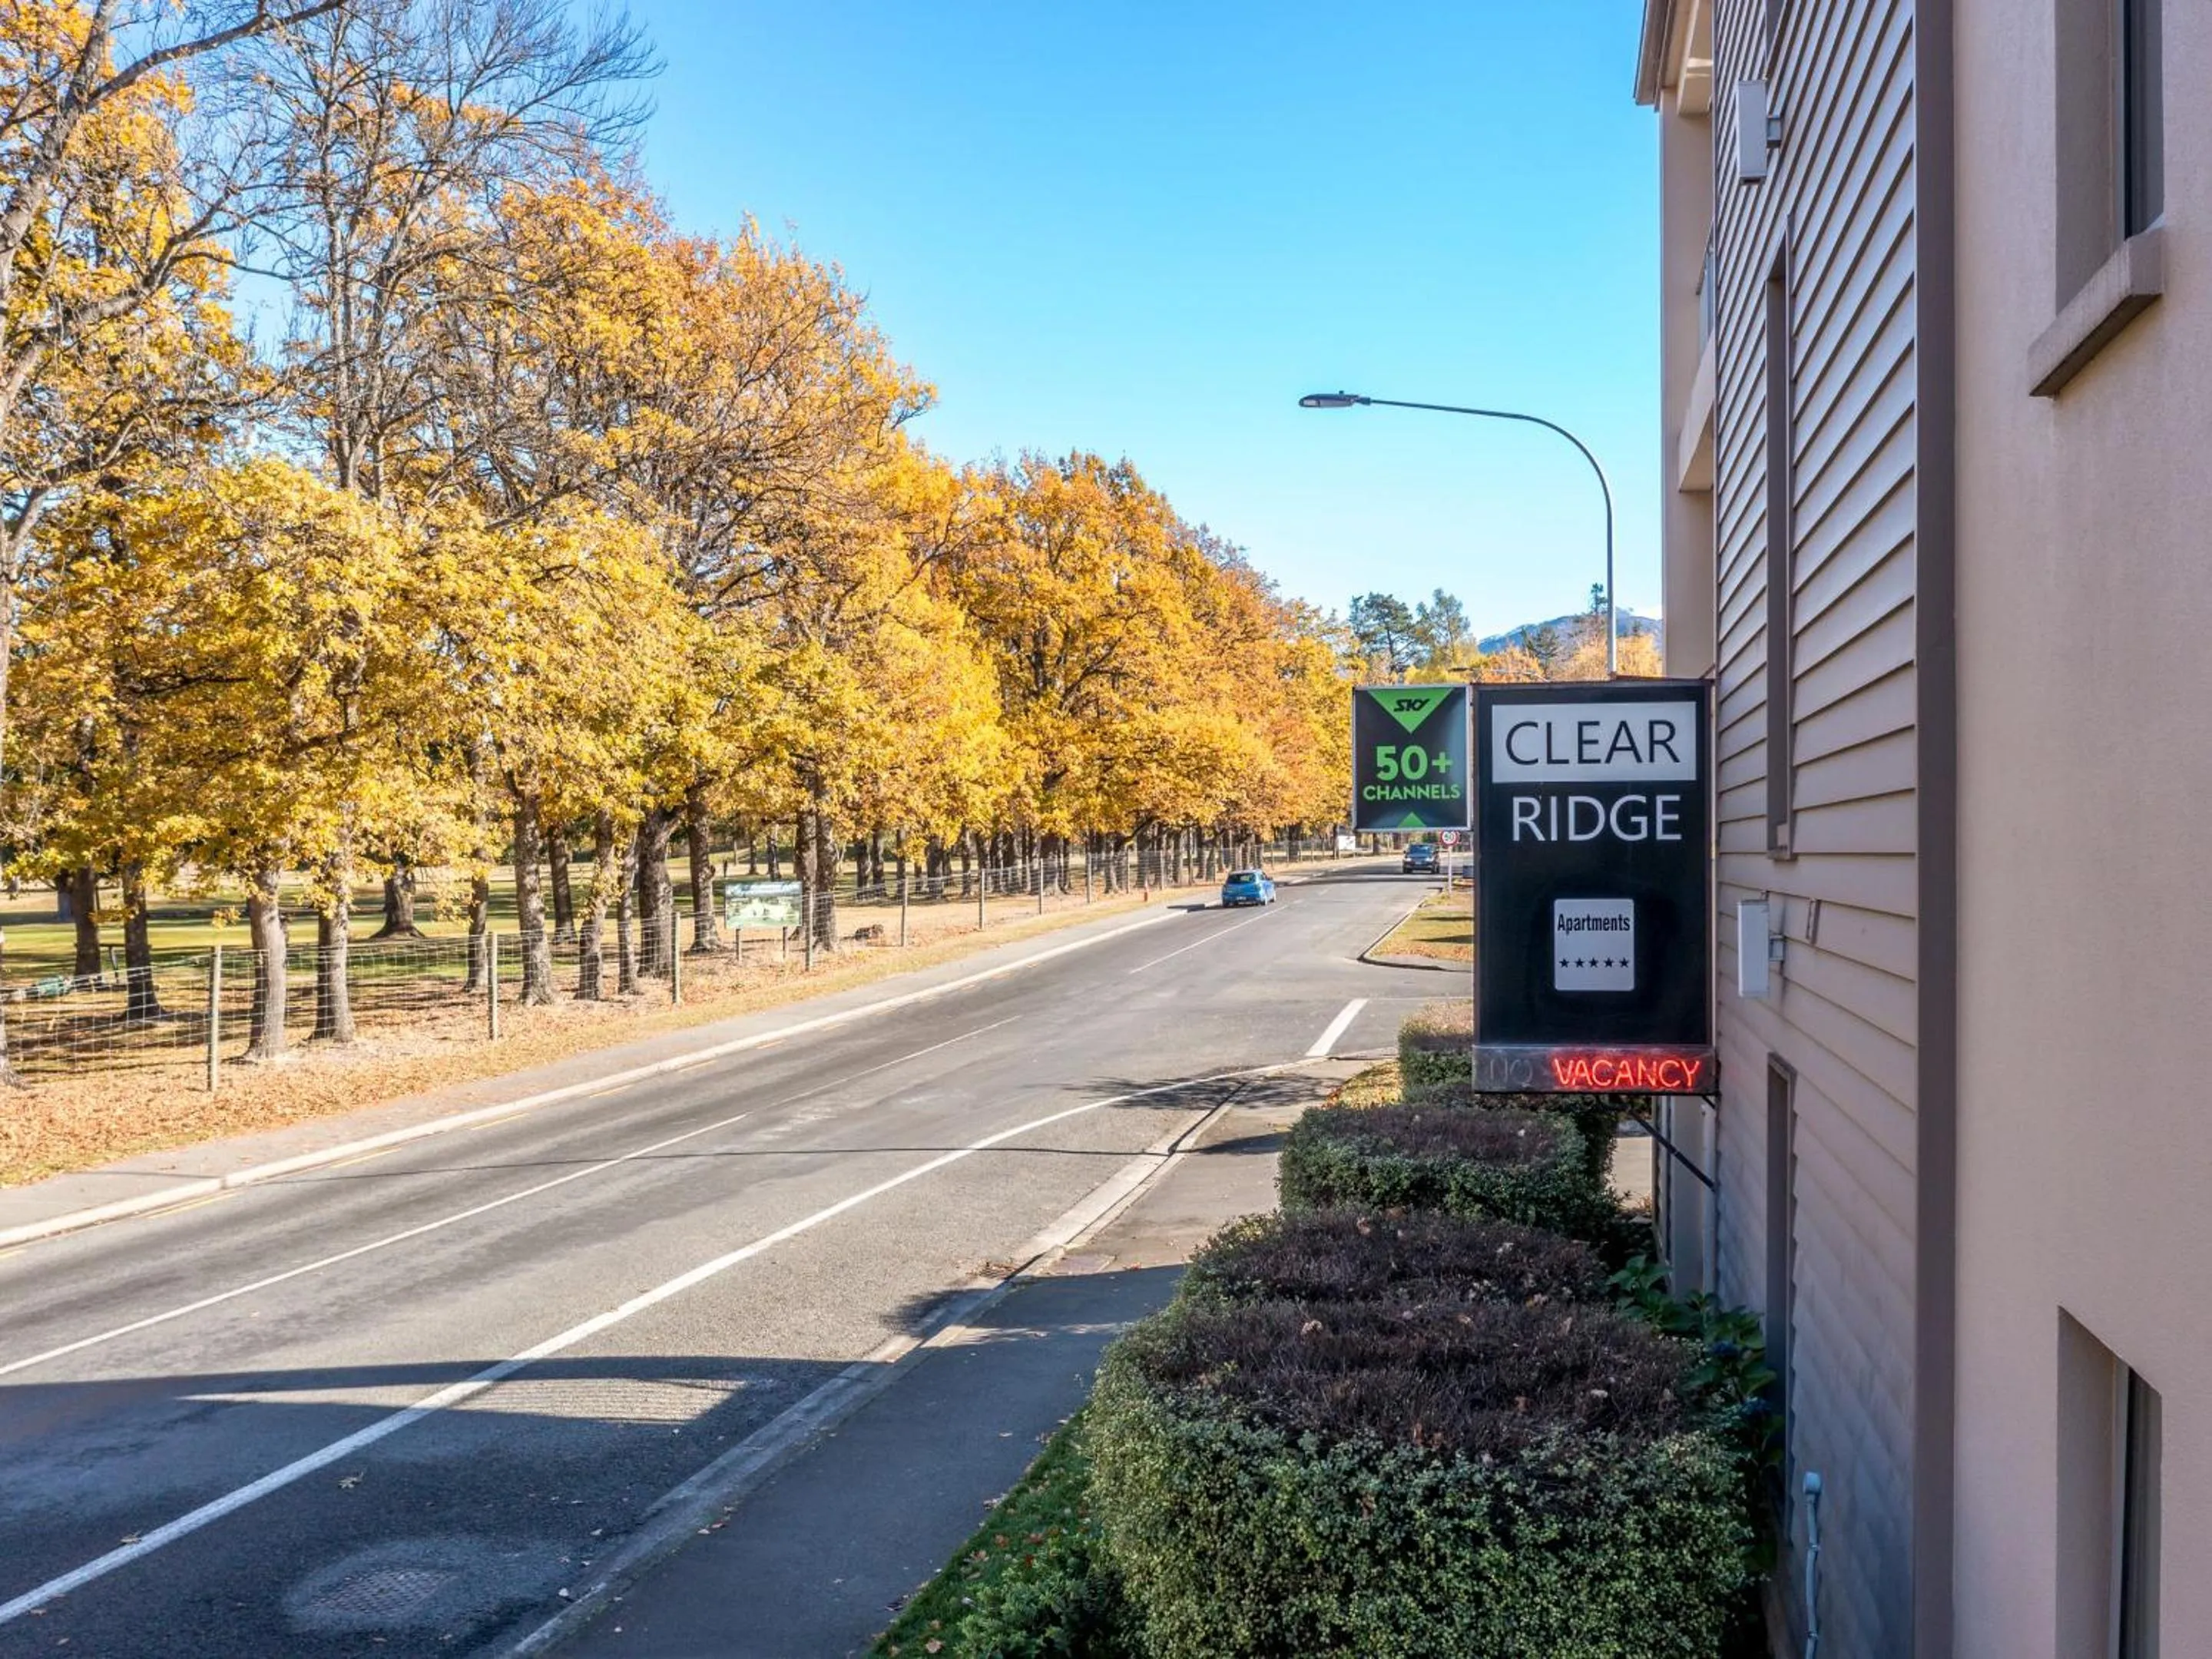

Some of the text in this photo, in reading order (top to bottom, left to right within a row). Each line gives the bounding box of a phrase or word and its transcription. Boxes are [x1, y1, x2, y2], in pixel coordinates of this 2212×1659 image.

[1394, 698, 1430, 712] SKY
[1506, 720, 1681, 766] CLEAR
[1376, 745, 1453, 780] 50+
[1363, 784, 1461, 800] CHANNELS
[1512, 795, 1682, 842] RIDGE
[1558, 914, 1630, 935] Apartments
[1554, 1058, 1700, 1088] VACANCY
